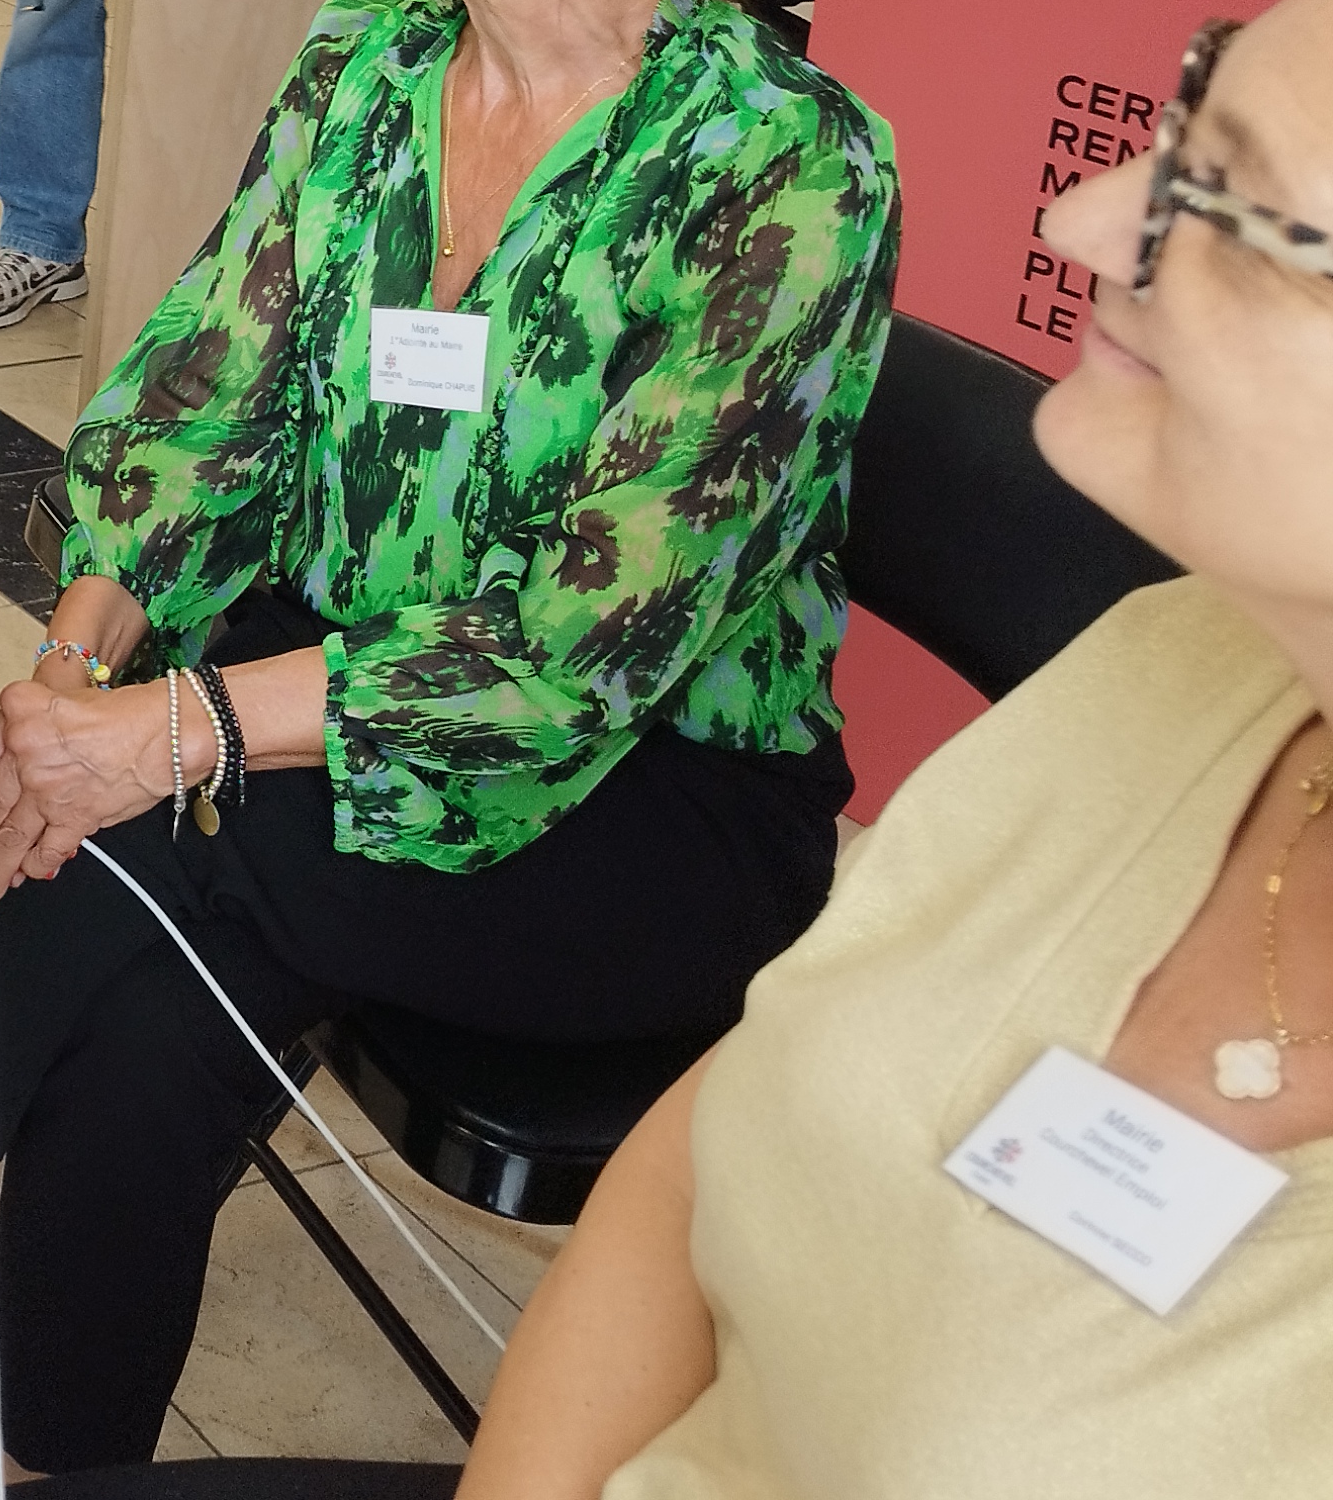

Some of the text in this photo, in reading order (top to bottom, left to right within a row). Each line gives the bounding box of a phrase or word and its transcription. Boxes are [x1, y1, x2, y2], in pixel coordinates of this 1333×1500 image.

[1056, 74, 1165, 131] CER
[412, 323, 439, 335] Mairie
[407, 378, 443, 390] Dominique
[1103, 1108, 1165, 1153] Mairie
